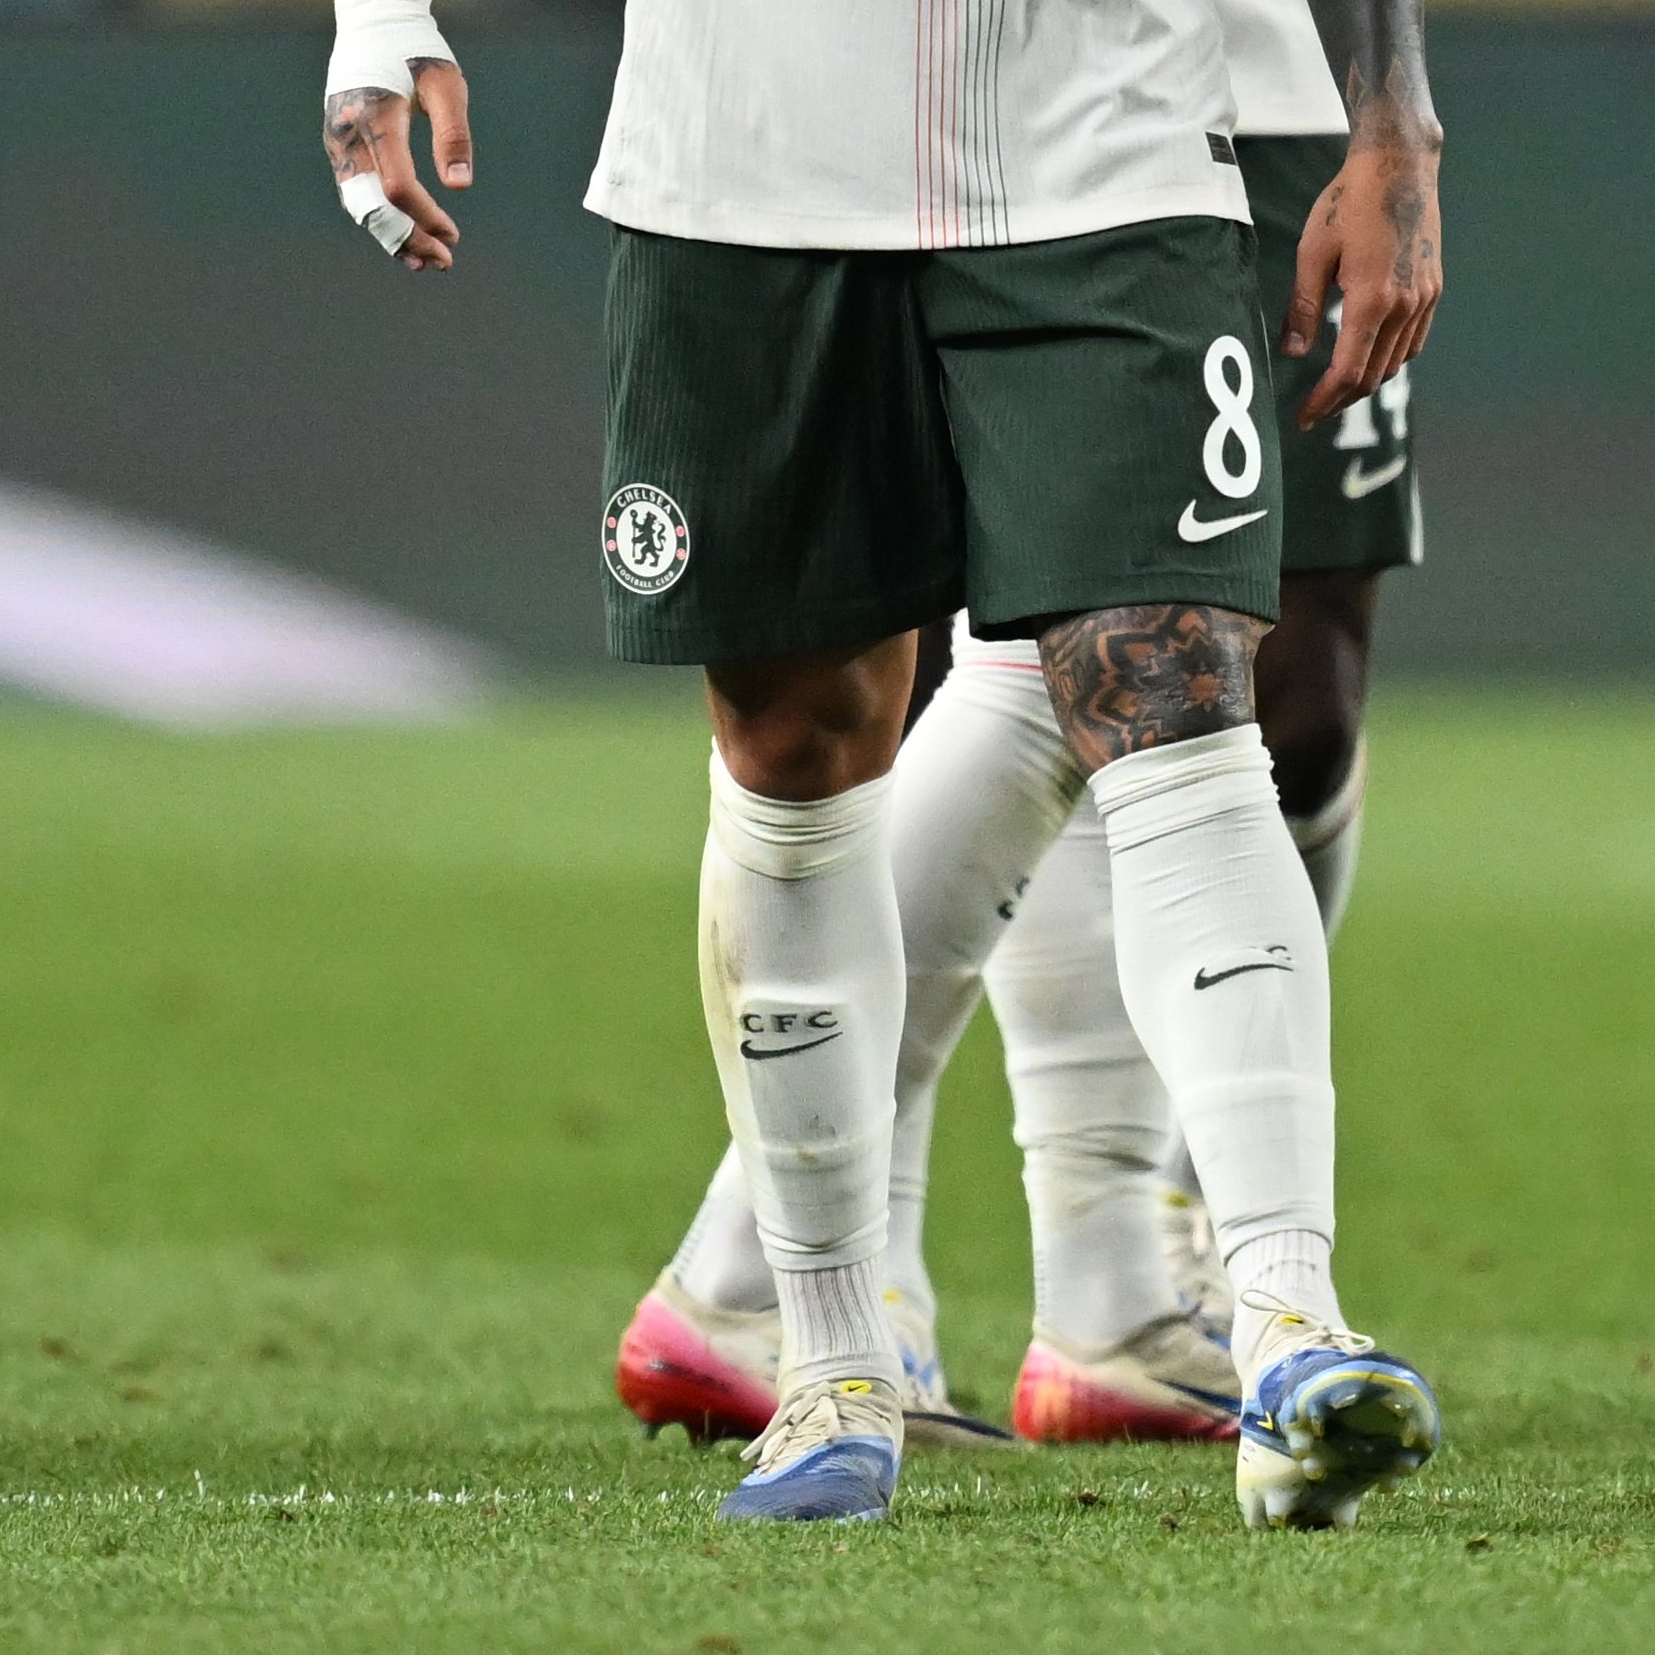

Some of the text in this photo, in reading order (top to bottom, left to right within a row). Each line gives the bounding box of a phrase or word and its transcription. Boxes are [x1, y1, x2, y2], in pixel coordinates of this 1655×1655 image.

[1202, 334, 1262, 499] 8
[616, 488, 672, 515] CHELSEA
[615, 564, 653, 588] FOOTBALL
[740, 1010, 838, 1034] CFC
